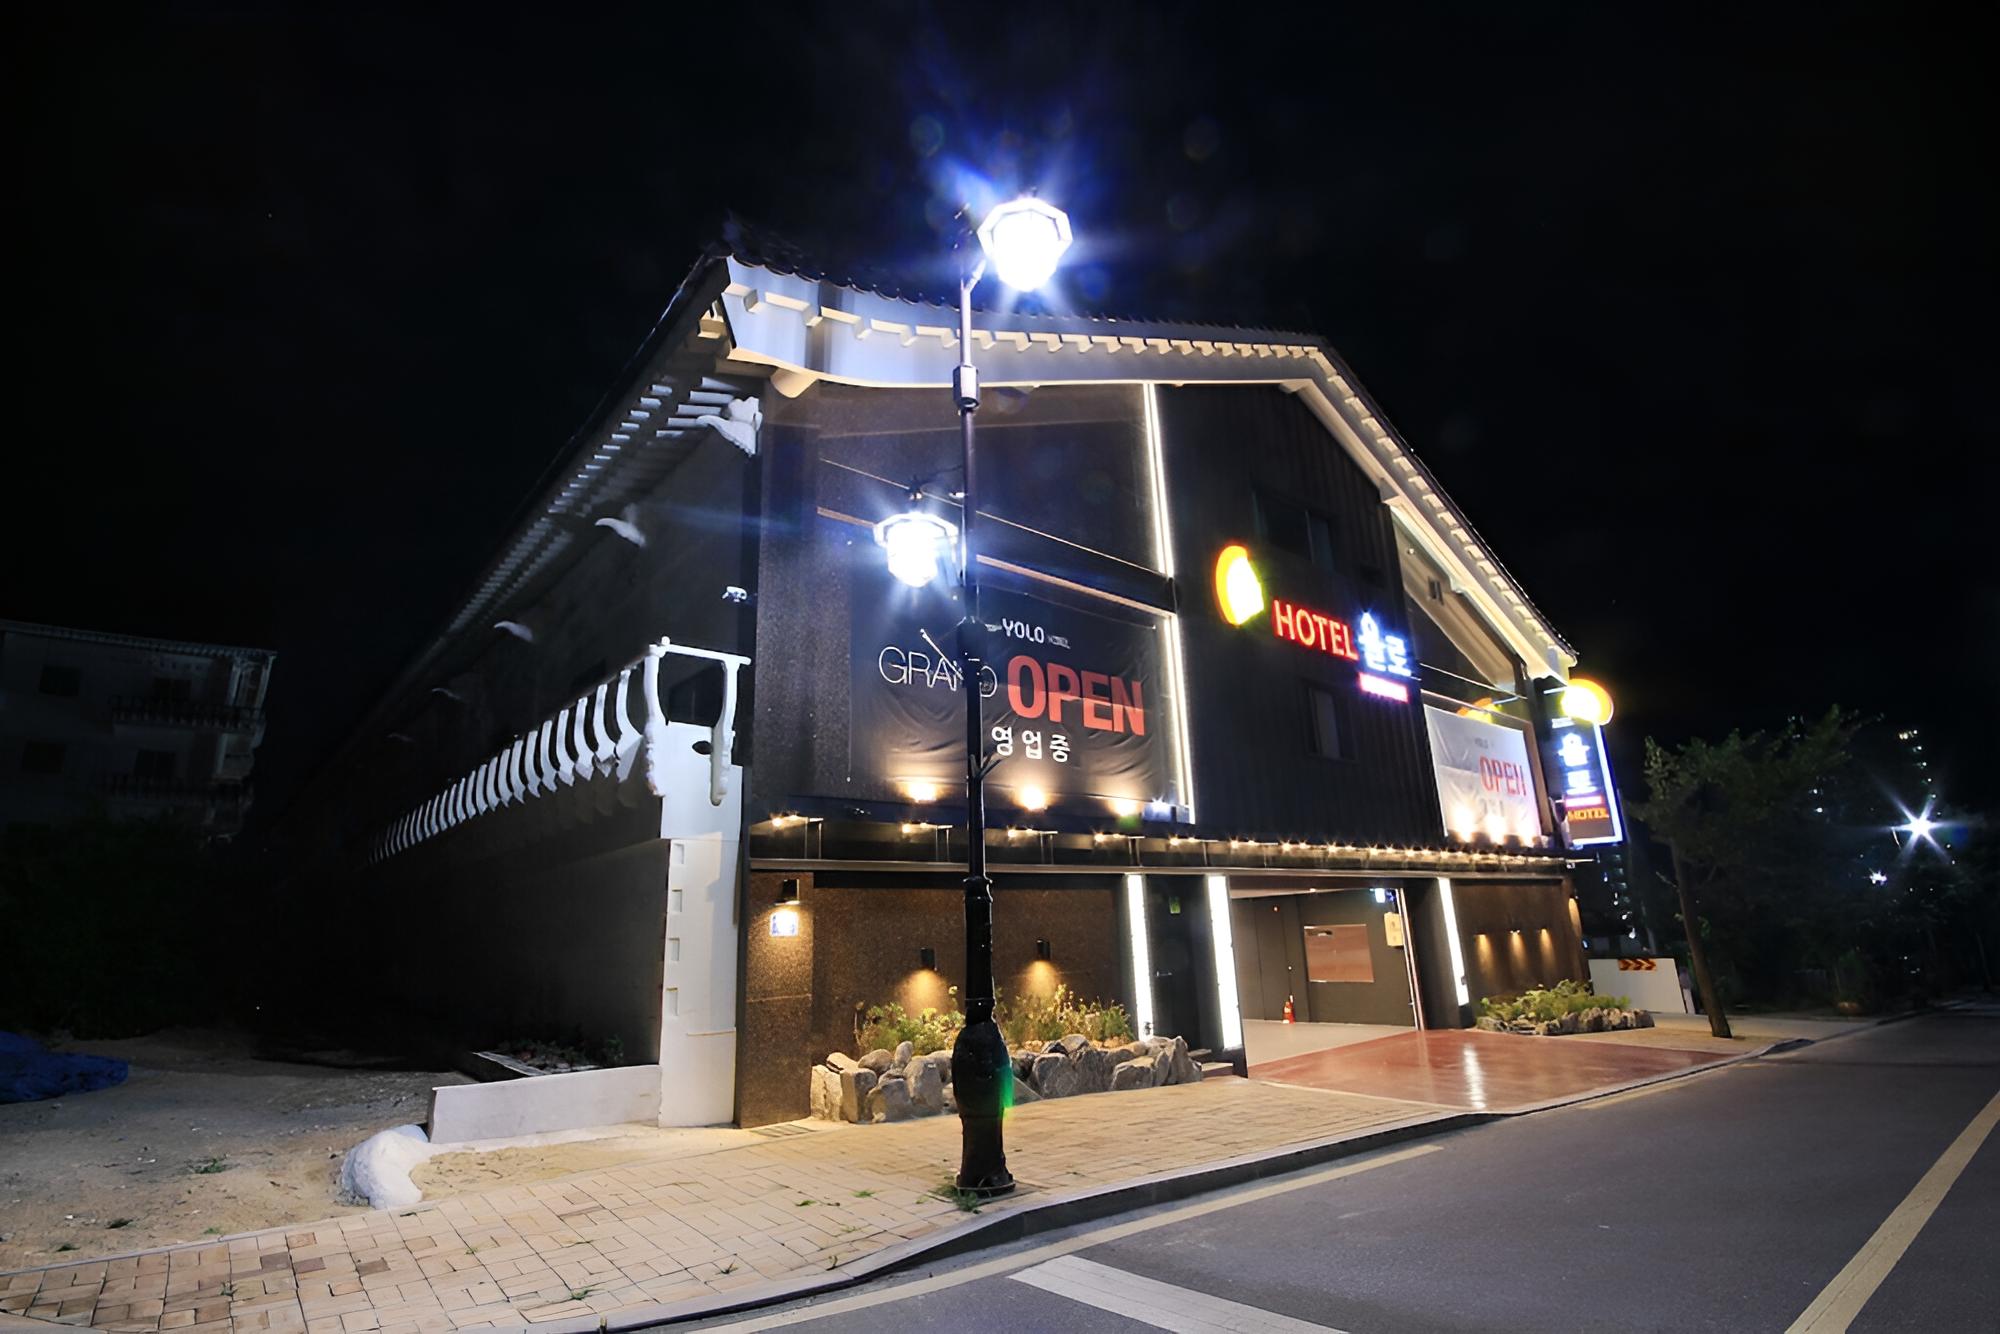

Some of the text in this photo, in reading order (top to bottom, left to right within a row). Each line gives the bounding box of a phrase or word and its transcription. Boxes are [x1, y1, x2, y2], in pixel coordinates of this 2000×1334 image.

[1002, 618, 1045, 644] YOLO
[1272, 598, 1360, 662] HOTEL
[878, 646, 1145, 737] GRAD OPEN
[991, 726, 1071, 763] 영업중
[1479, 755, 1527, 796] OPEN
